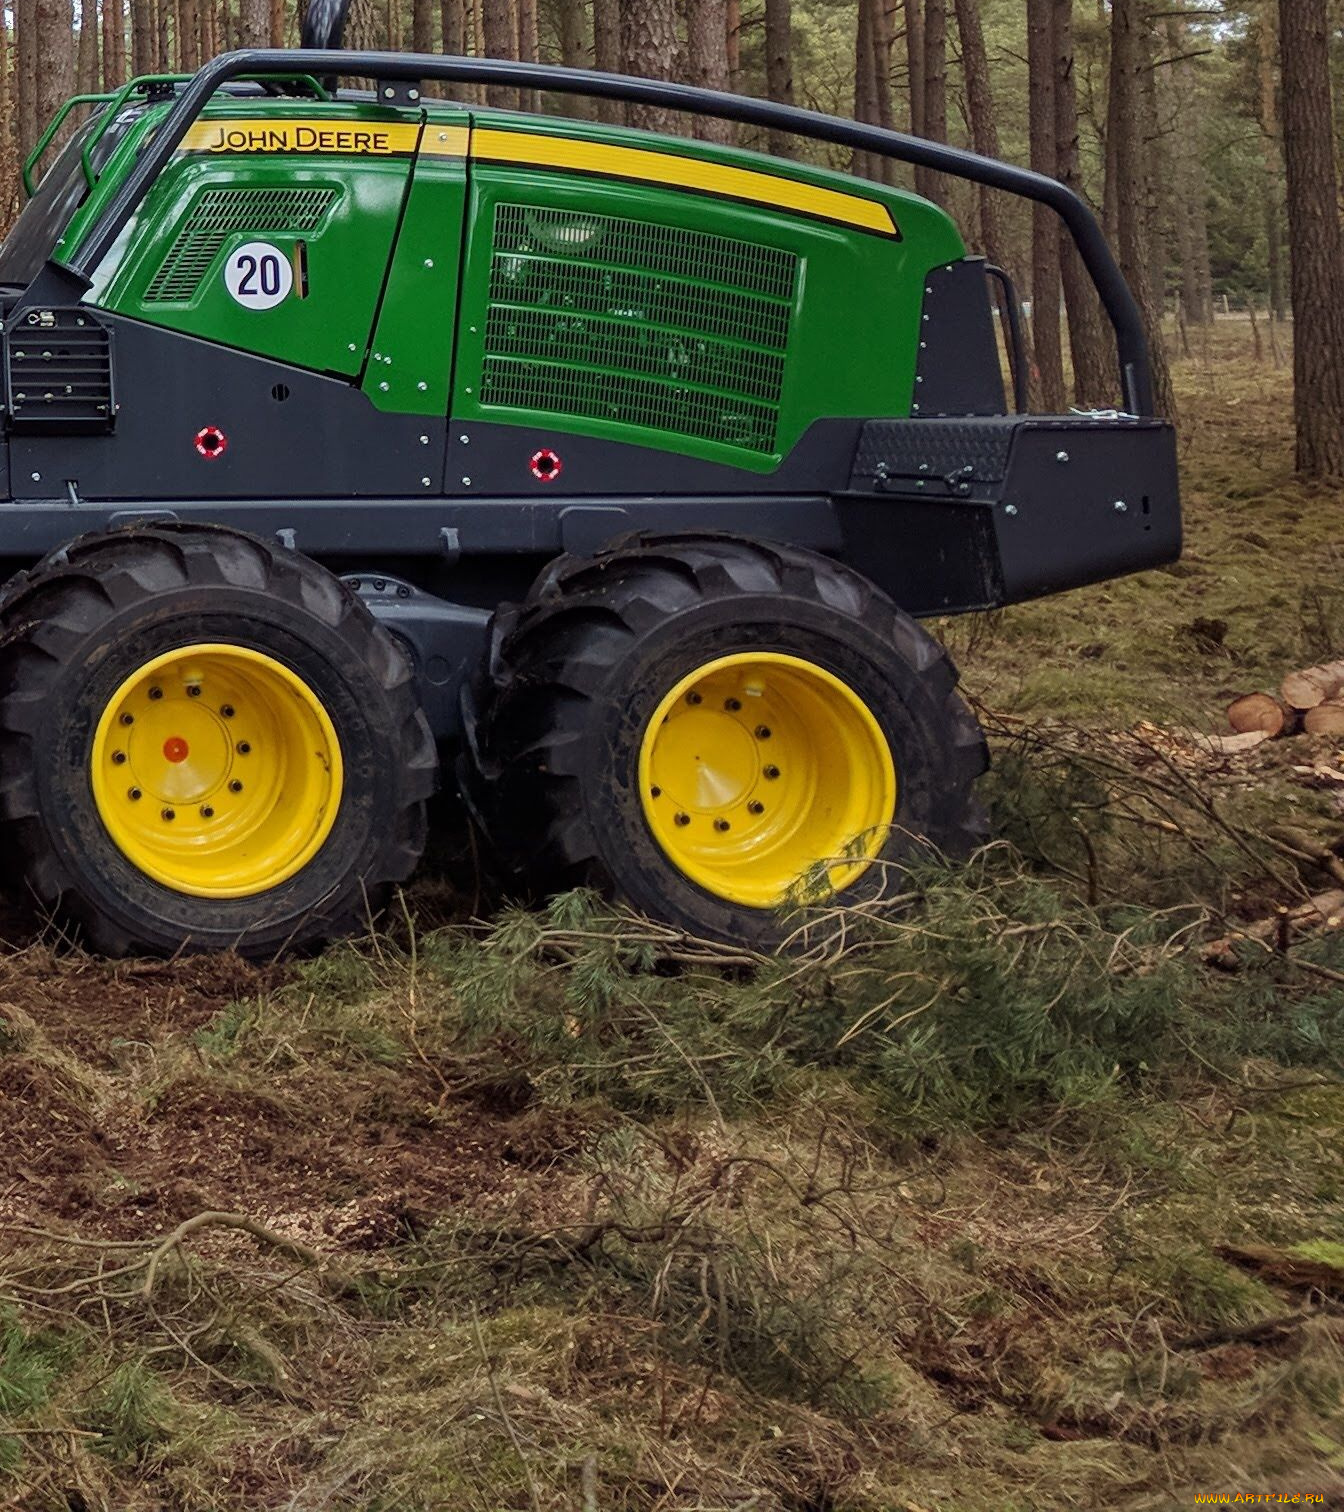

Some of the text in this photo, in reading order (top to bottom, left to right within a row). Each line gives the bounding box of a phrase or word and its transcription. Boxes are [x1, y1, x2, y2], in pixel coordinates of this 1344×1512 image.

[212, 127, 389, 150] JOHN DEERE
[236, 254, 282, 296] 20
